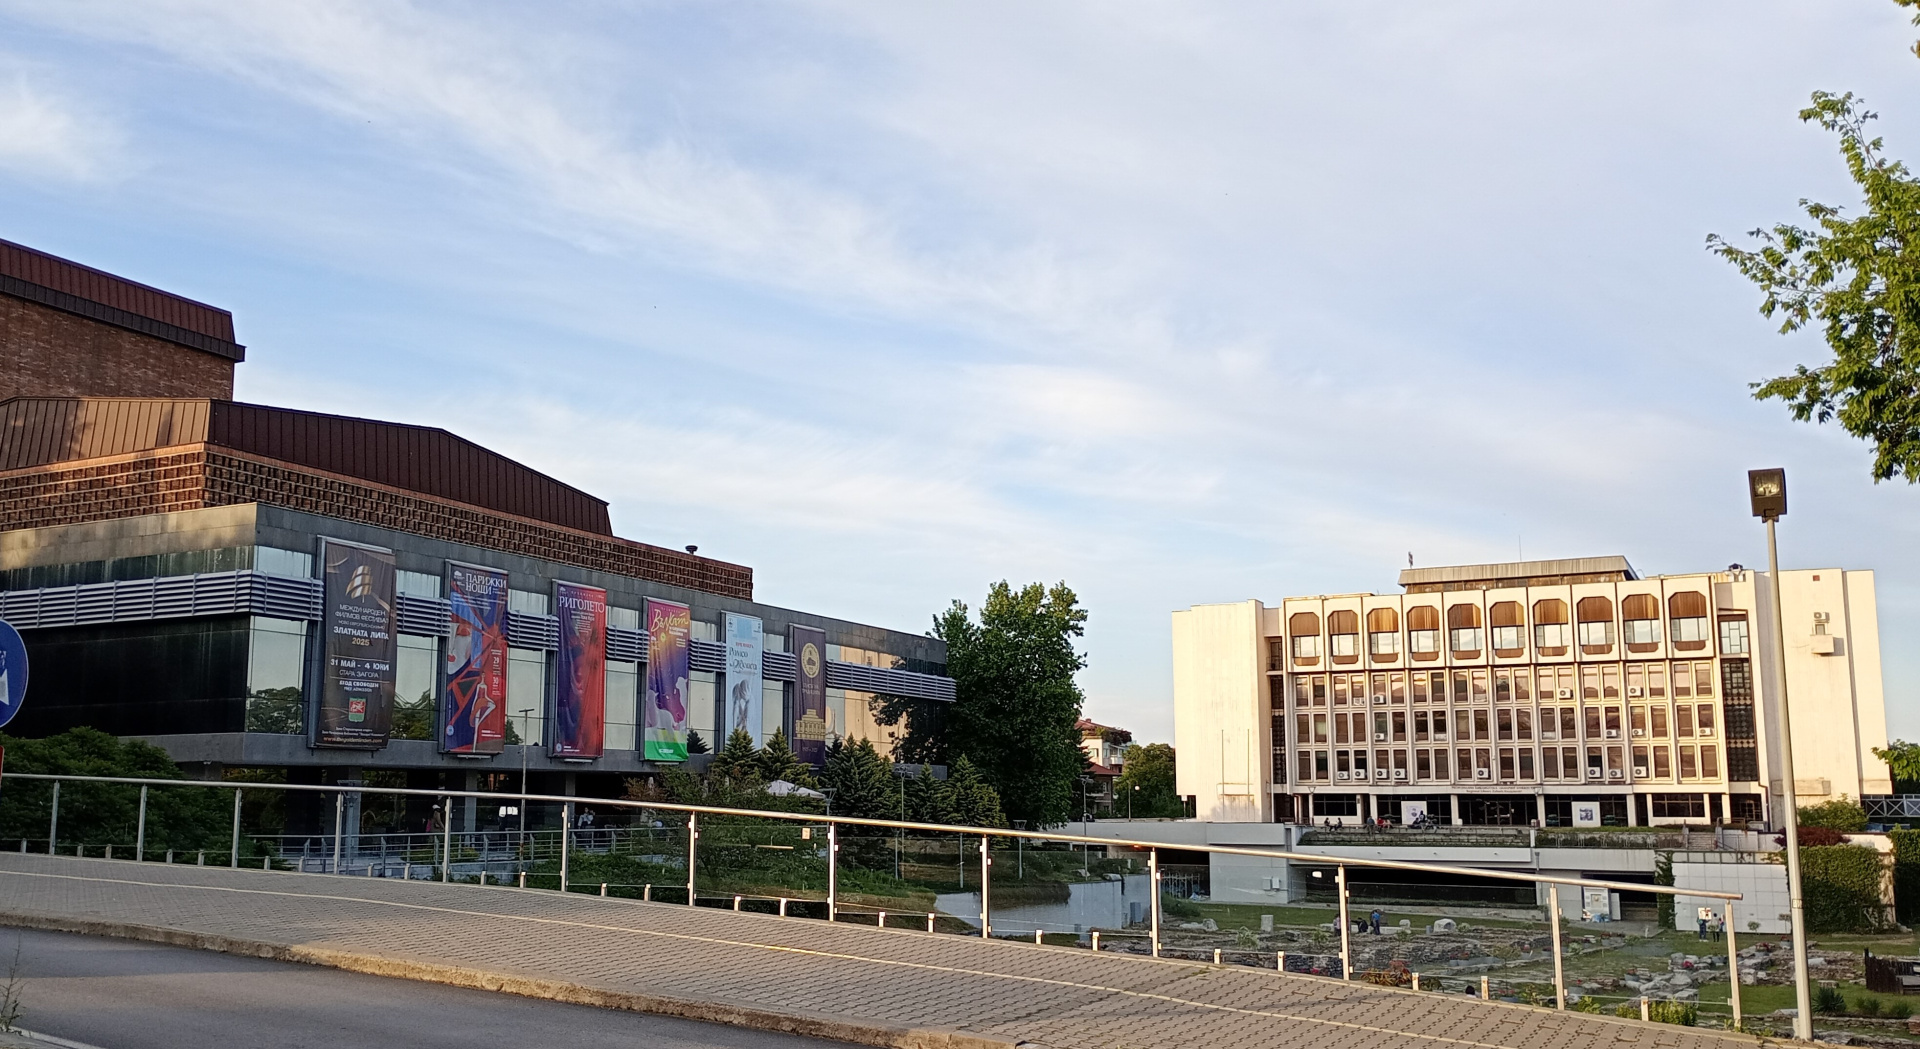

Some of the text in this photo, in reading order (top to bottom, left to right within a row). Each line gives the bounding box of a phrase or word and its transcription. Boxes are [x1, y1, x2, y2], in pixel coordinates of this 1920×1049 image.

[465, 572, 507, 589] ПАРИЖКИ
[465, 582, 492, 595] НОЩИ
[339, 603, 386, 616] МЕЖДУНАРОДЕН
[558, 595, 605, 613] РИГОЛЕТО
[334, 611, 360, 620] ФИЛМОВ
[333, 626, 389, 640] ЗЛАТНАТА ЛИПА
[351, 637, 370, 646] 2025
[330, 658, 339, 666] 31
[340, 659, 356, 668] МАЙ
[373, 662, 390, 671] ЮНИ
[339, 669, 355, 677] СТАРА
